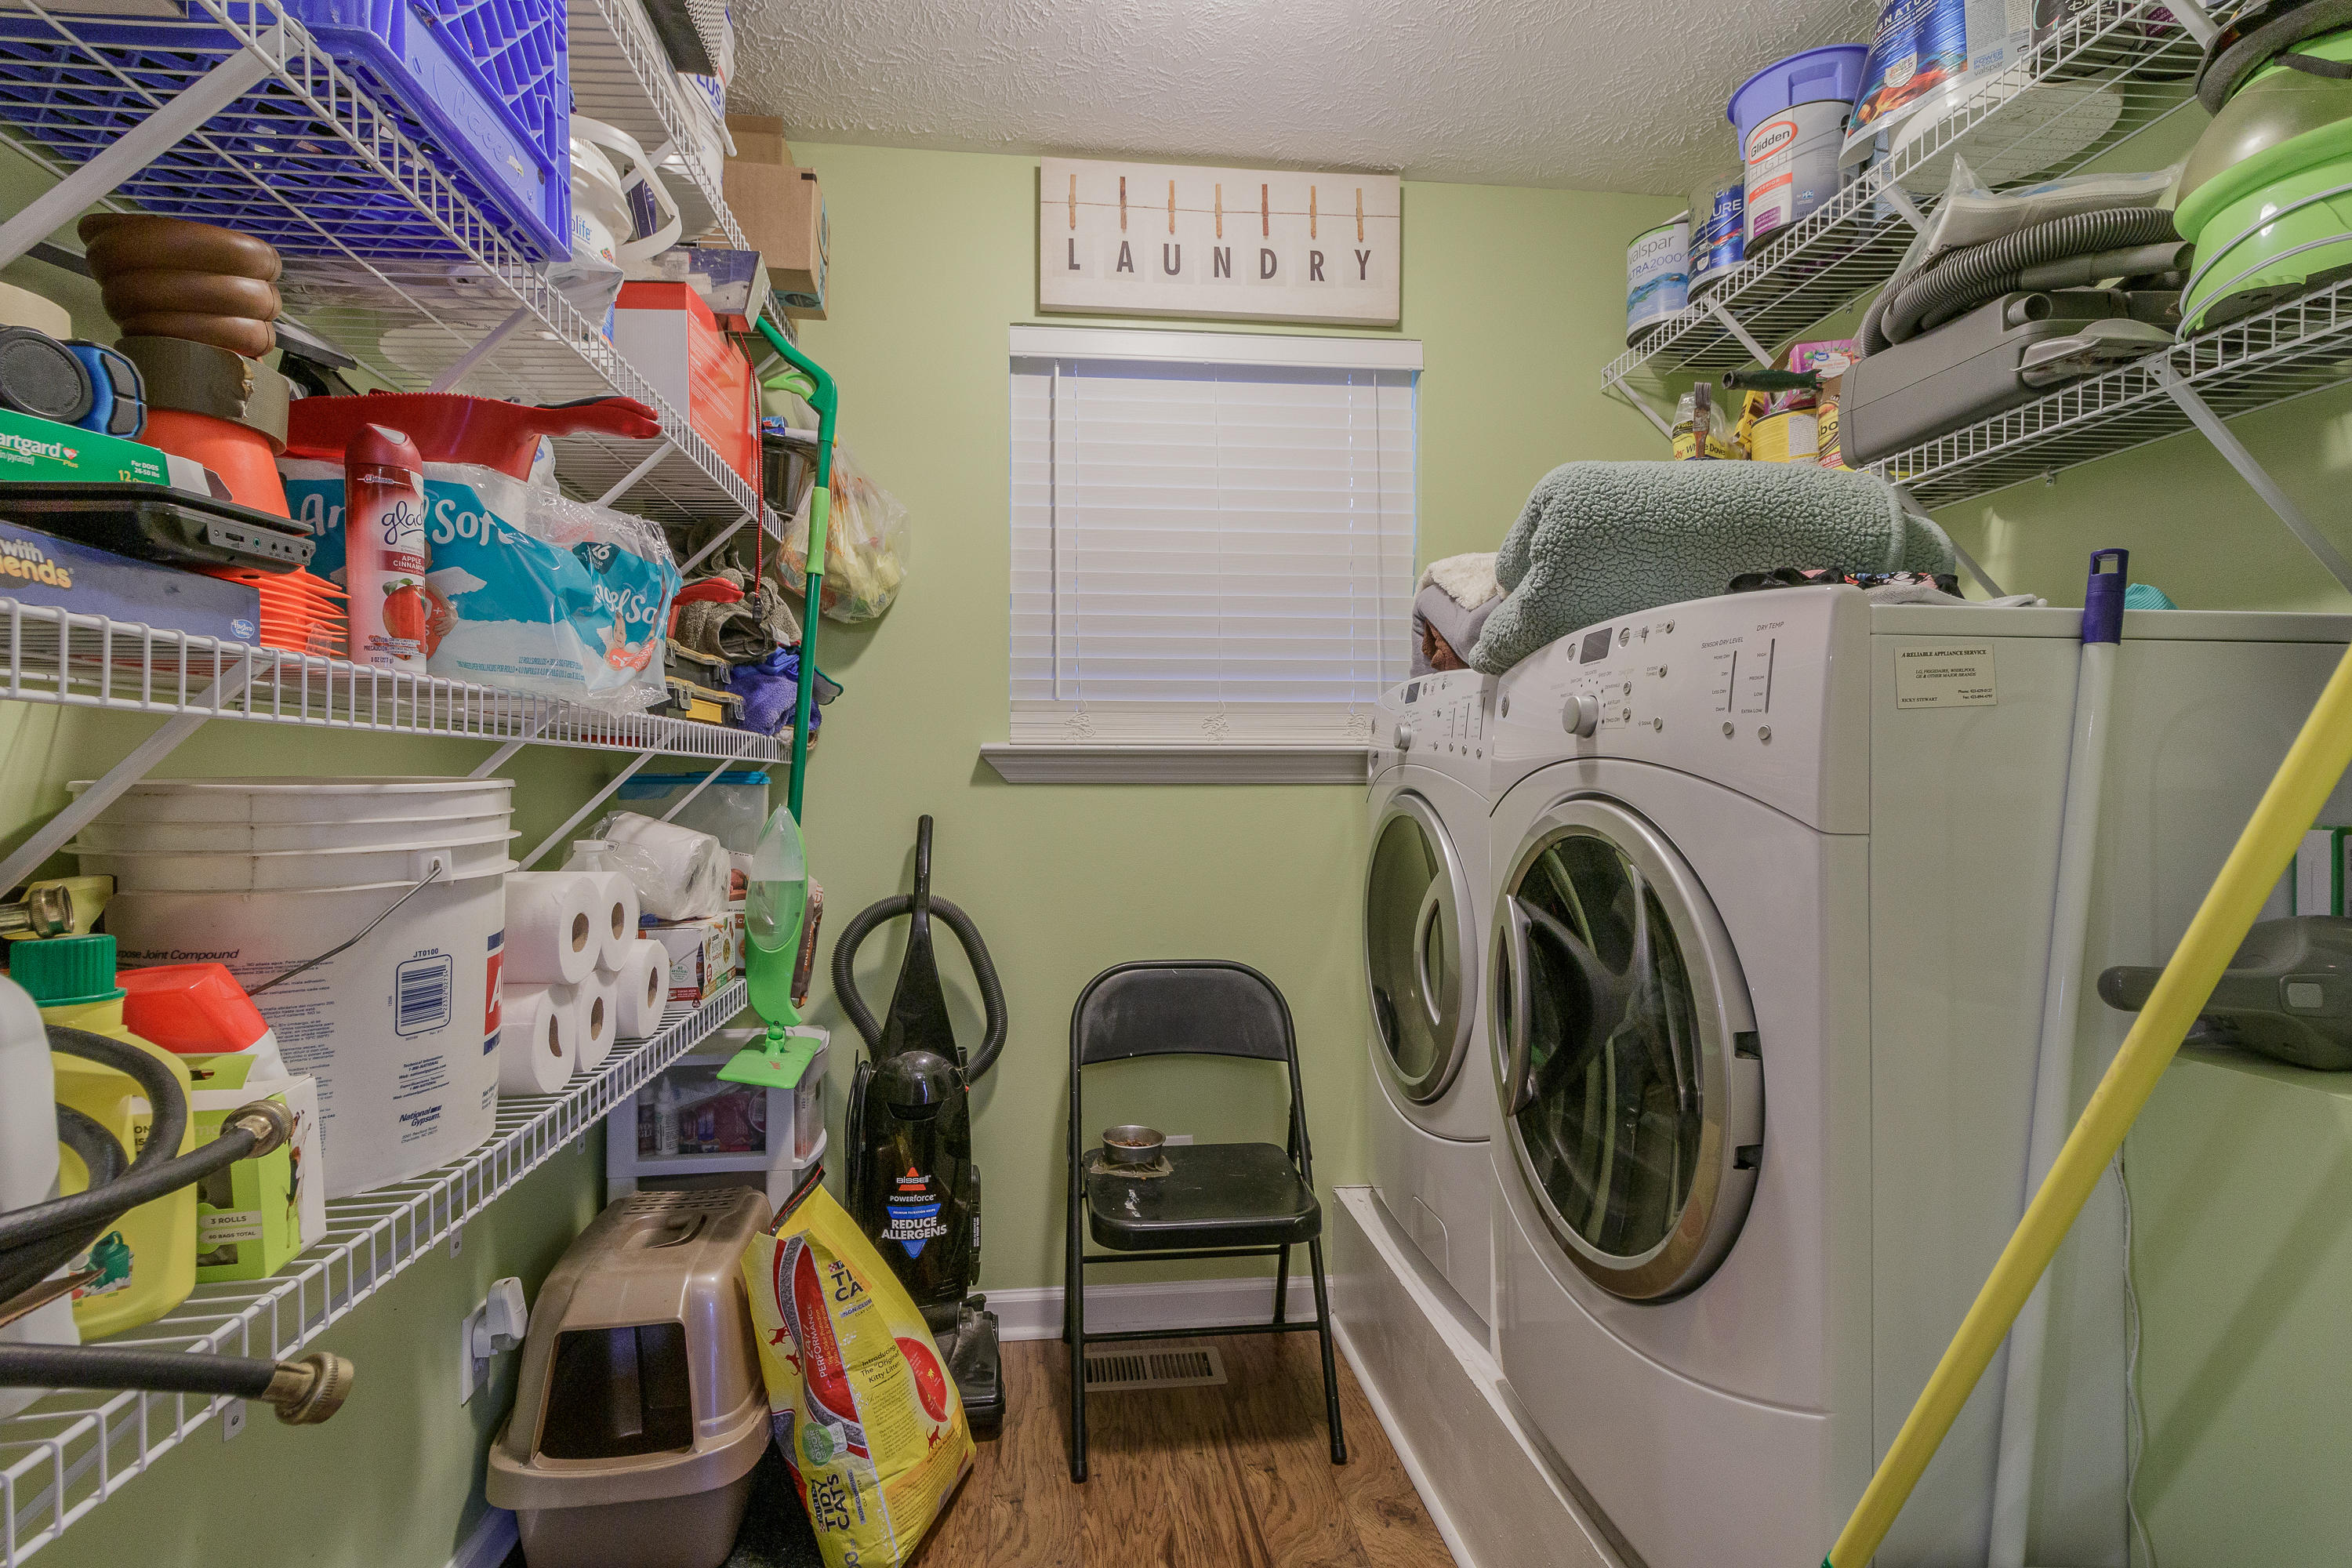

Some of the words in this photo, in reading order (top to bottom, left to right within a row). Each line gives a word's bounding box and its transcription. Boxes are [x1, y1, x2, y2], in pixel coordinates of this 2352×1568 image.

[1974, 51, 2003, 66] POWER
[1974, 60, 2004, 76] valspar
[1751, 129, 1790, 158] Glidden
[1750, 151, 1788, 180] HIGH
[1712, 198, 1742, 217] URE
[1628, 233, 1675, 266] valspar
[1068, 238, 1371, 281] LAUNDRY
[1819, 420, 1838, 437] bo
[0, 432, 61, 458] artgard
[1686, 443, 1708, 454] Whe
[0, 452, 34, 466] in/pyrantel)
[63, 459, 78, 469] Plus
[1831, 452, 1842, 462] DEC
[142, 461, 159, 471] DOGS
[118, 470, 131, 482] 12
[381, 500, 424, 545] glad
[2, 537, 45, 563] with
[393, 560, 424, 572] CINNAMO
[402, 555, 422, 565] APPLE
[0, 555, 73, 589] iends
[594, 583, 631, 617] ngel
[625, 594, 659, 624] So
[1769, 621, 1784, 630] TEMP
[143, 949, 169, 960] Joint
[170, 949, 240, 961] Compound
[413, 948, 439, 958] JT0100
[488, 965, 503, 1014] A
[399, 1106, 431, 1123] National
[218, 1215, 247, 1224] ROLLS
[891, 1216, 937, 1229] REDUCE
[881, 1225, 947, 1240] ALLERGENS
[830, 1269, 853, 1287] TI
[835, 1281, 864, 1301] CA
[843, 1298, 872, 1317] NON-CLUM
[807, 1303, 828, 1377] PERFORMANCE
[861, 1367, 873, 1377] The
[869, 1372, 884, 1383] Kitty
[811, 1479, 823, 1523] PURIN
[815, 1479, 837, 1533] TIDY
[826, 1473, 851, 1530] CATS
